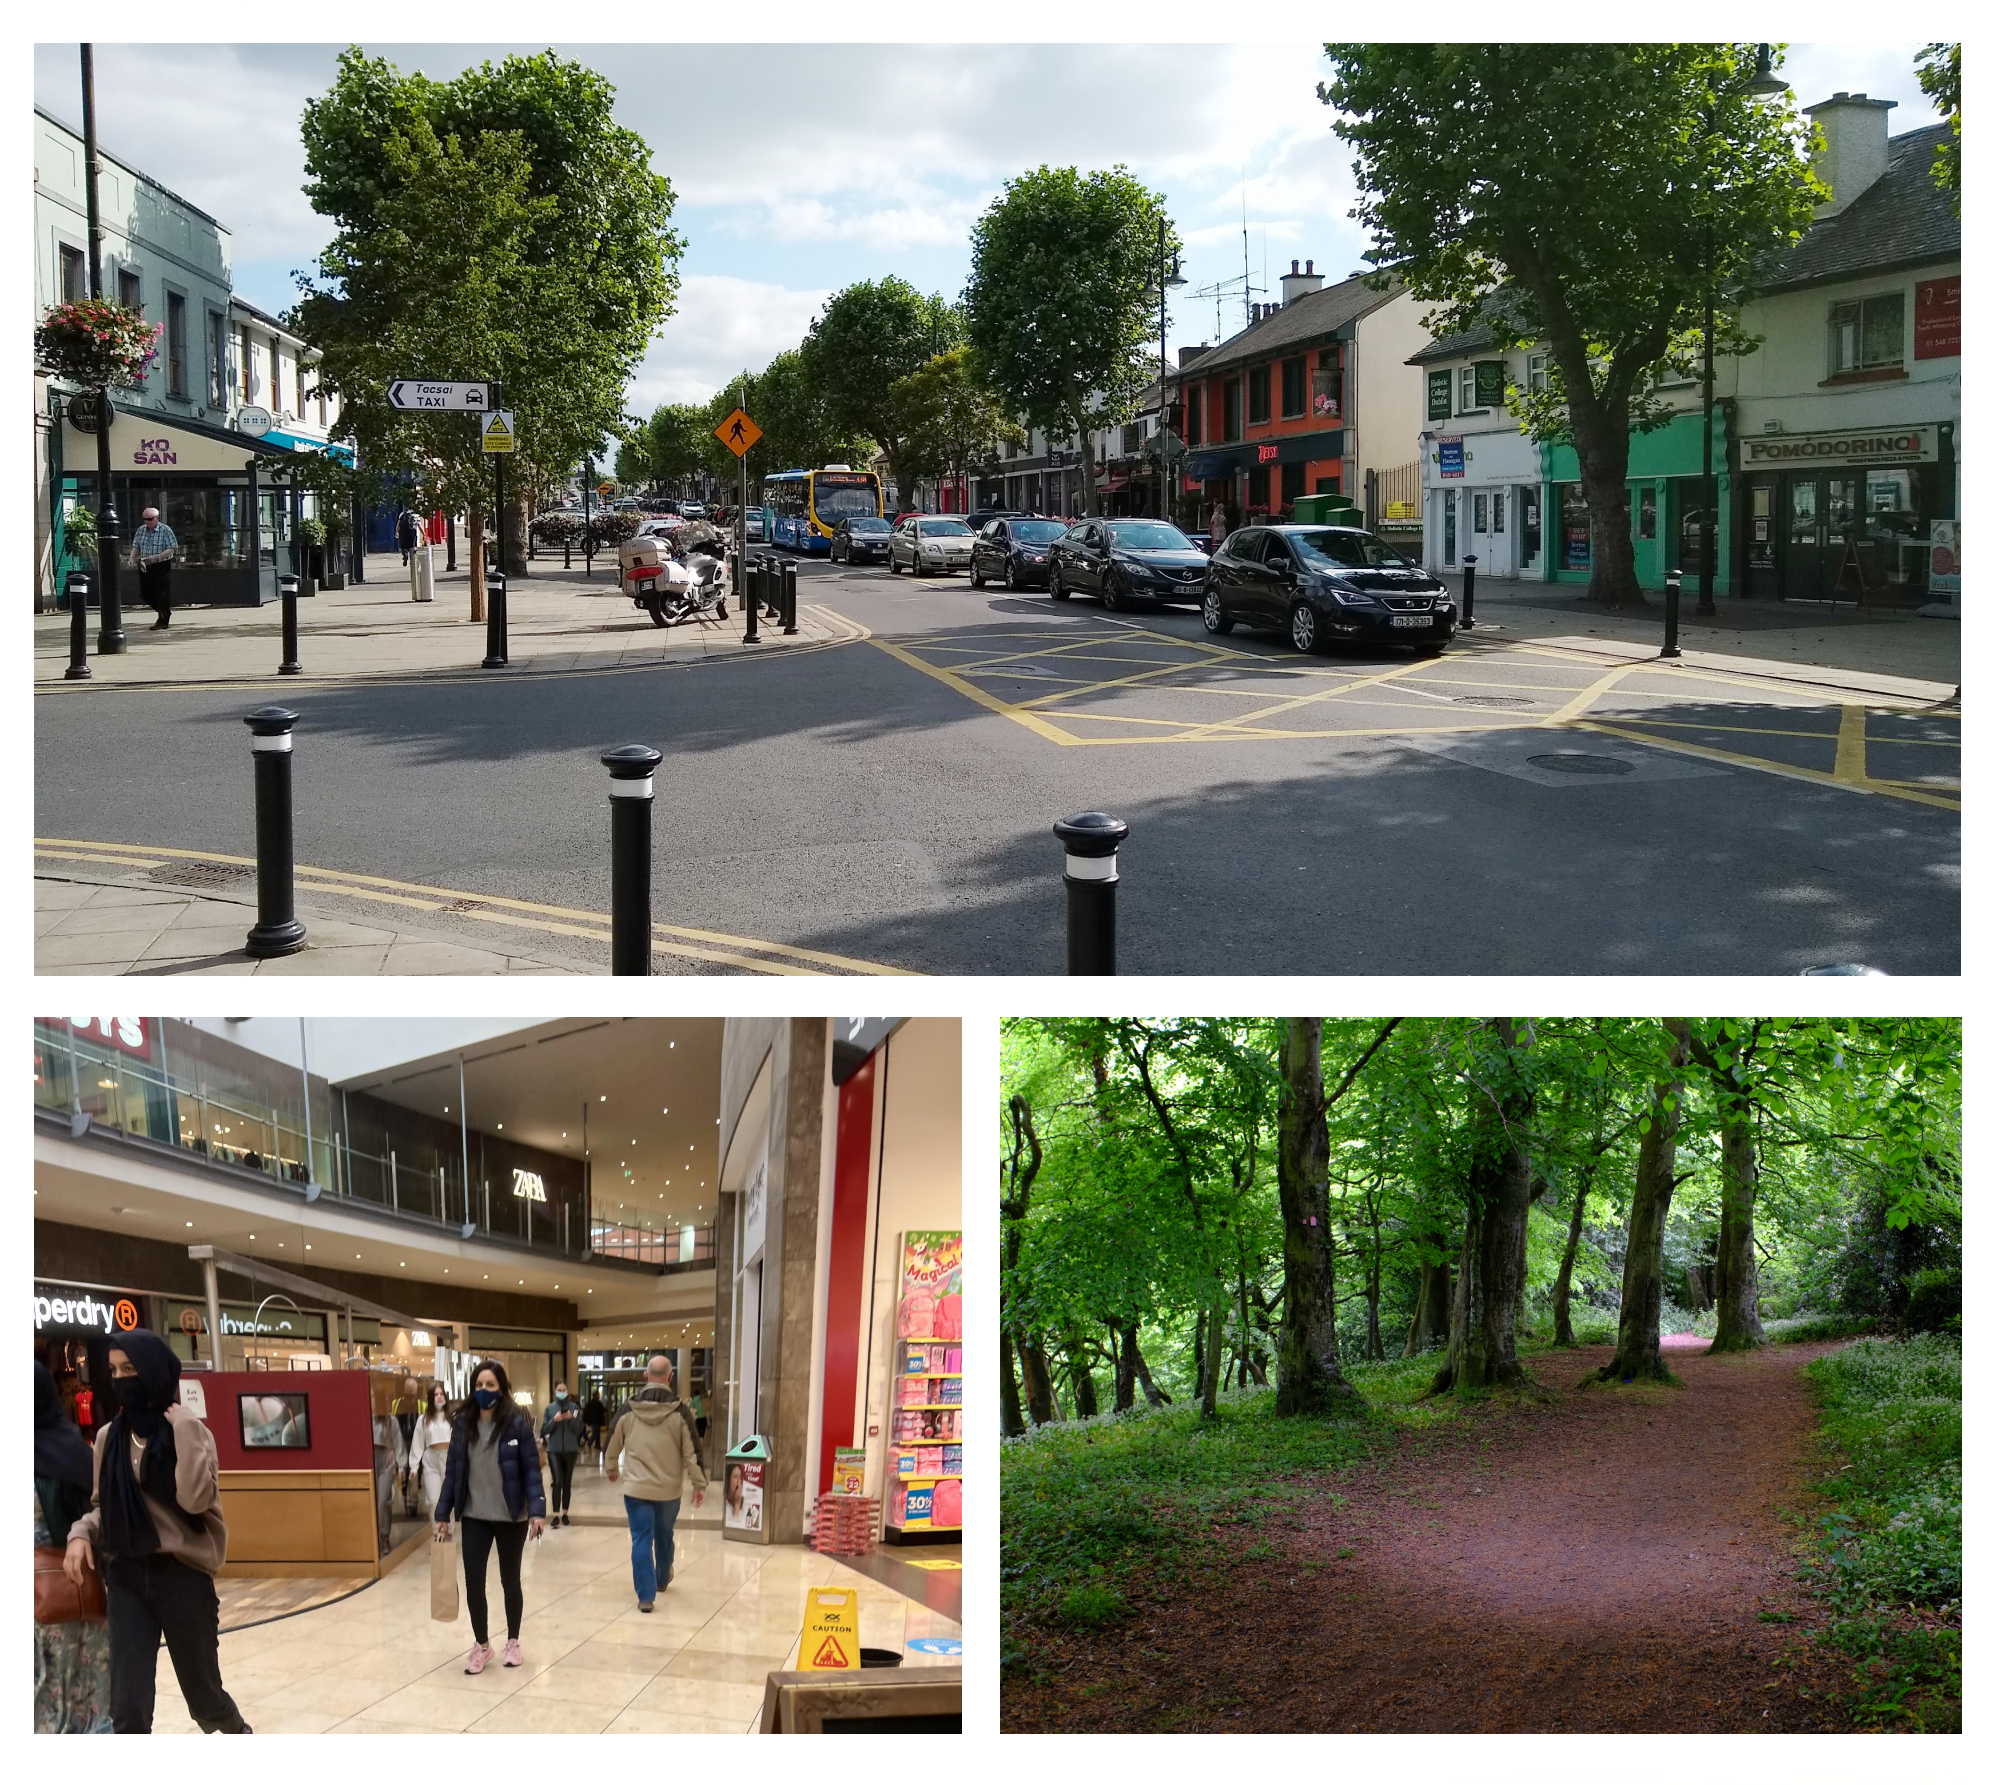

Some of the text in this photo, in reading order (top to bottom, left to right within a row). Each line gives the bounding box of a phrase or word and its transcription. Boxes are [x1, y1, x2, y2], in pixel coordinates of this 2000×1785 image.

[1430, 378, 1448, 387] Holistic
[1430, 389, 1448, 397] College
[417, 397, 446, 407] TAXI
[1431, 398, 1448, 406] Dublin
[141, 439, 170, 452] KO
[1751, 436, 1911, 460] POMODORINO
[133, 452, 177, 465] SAN
[513, 1168, 547, 1202] ZARA
[907, 1253, 960, 1283] Magical
[743, 1463, 761, 1473] Tired
[812, 1624, 852, 1633] CAUTION
